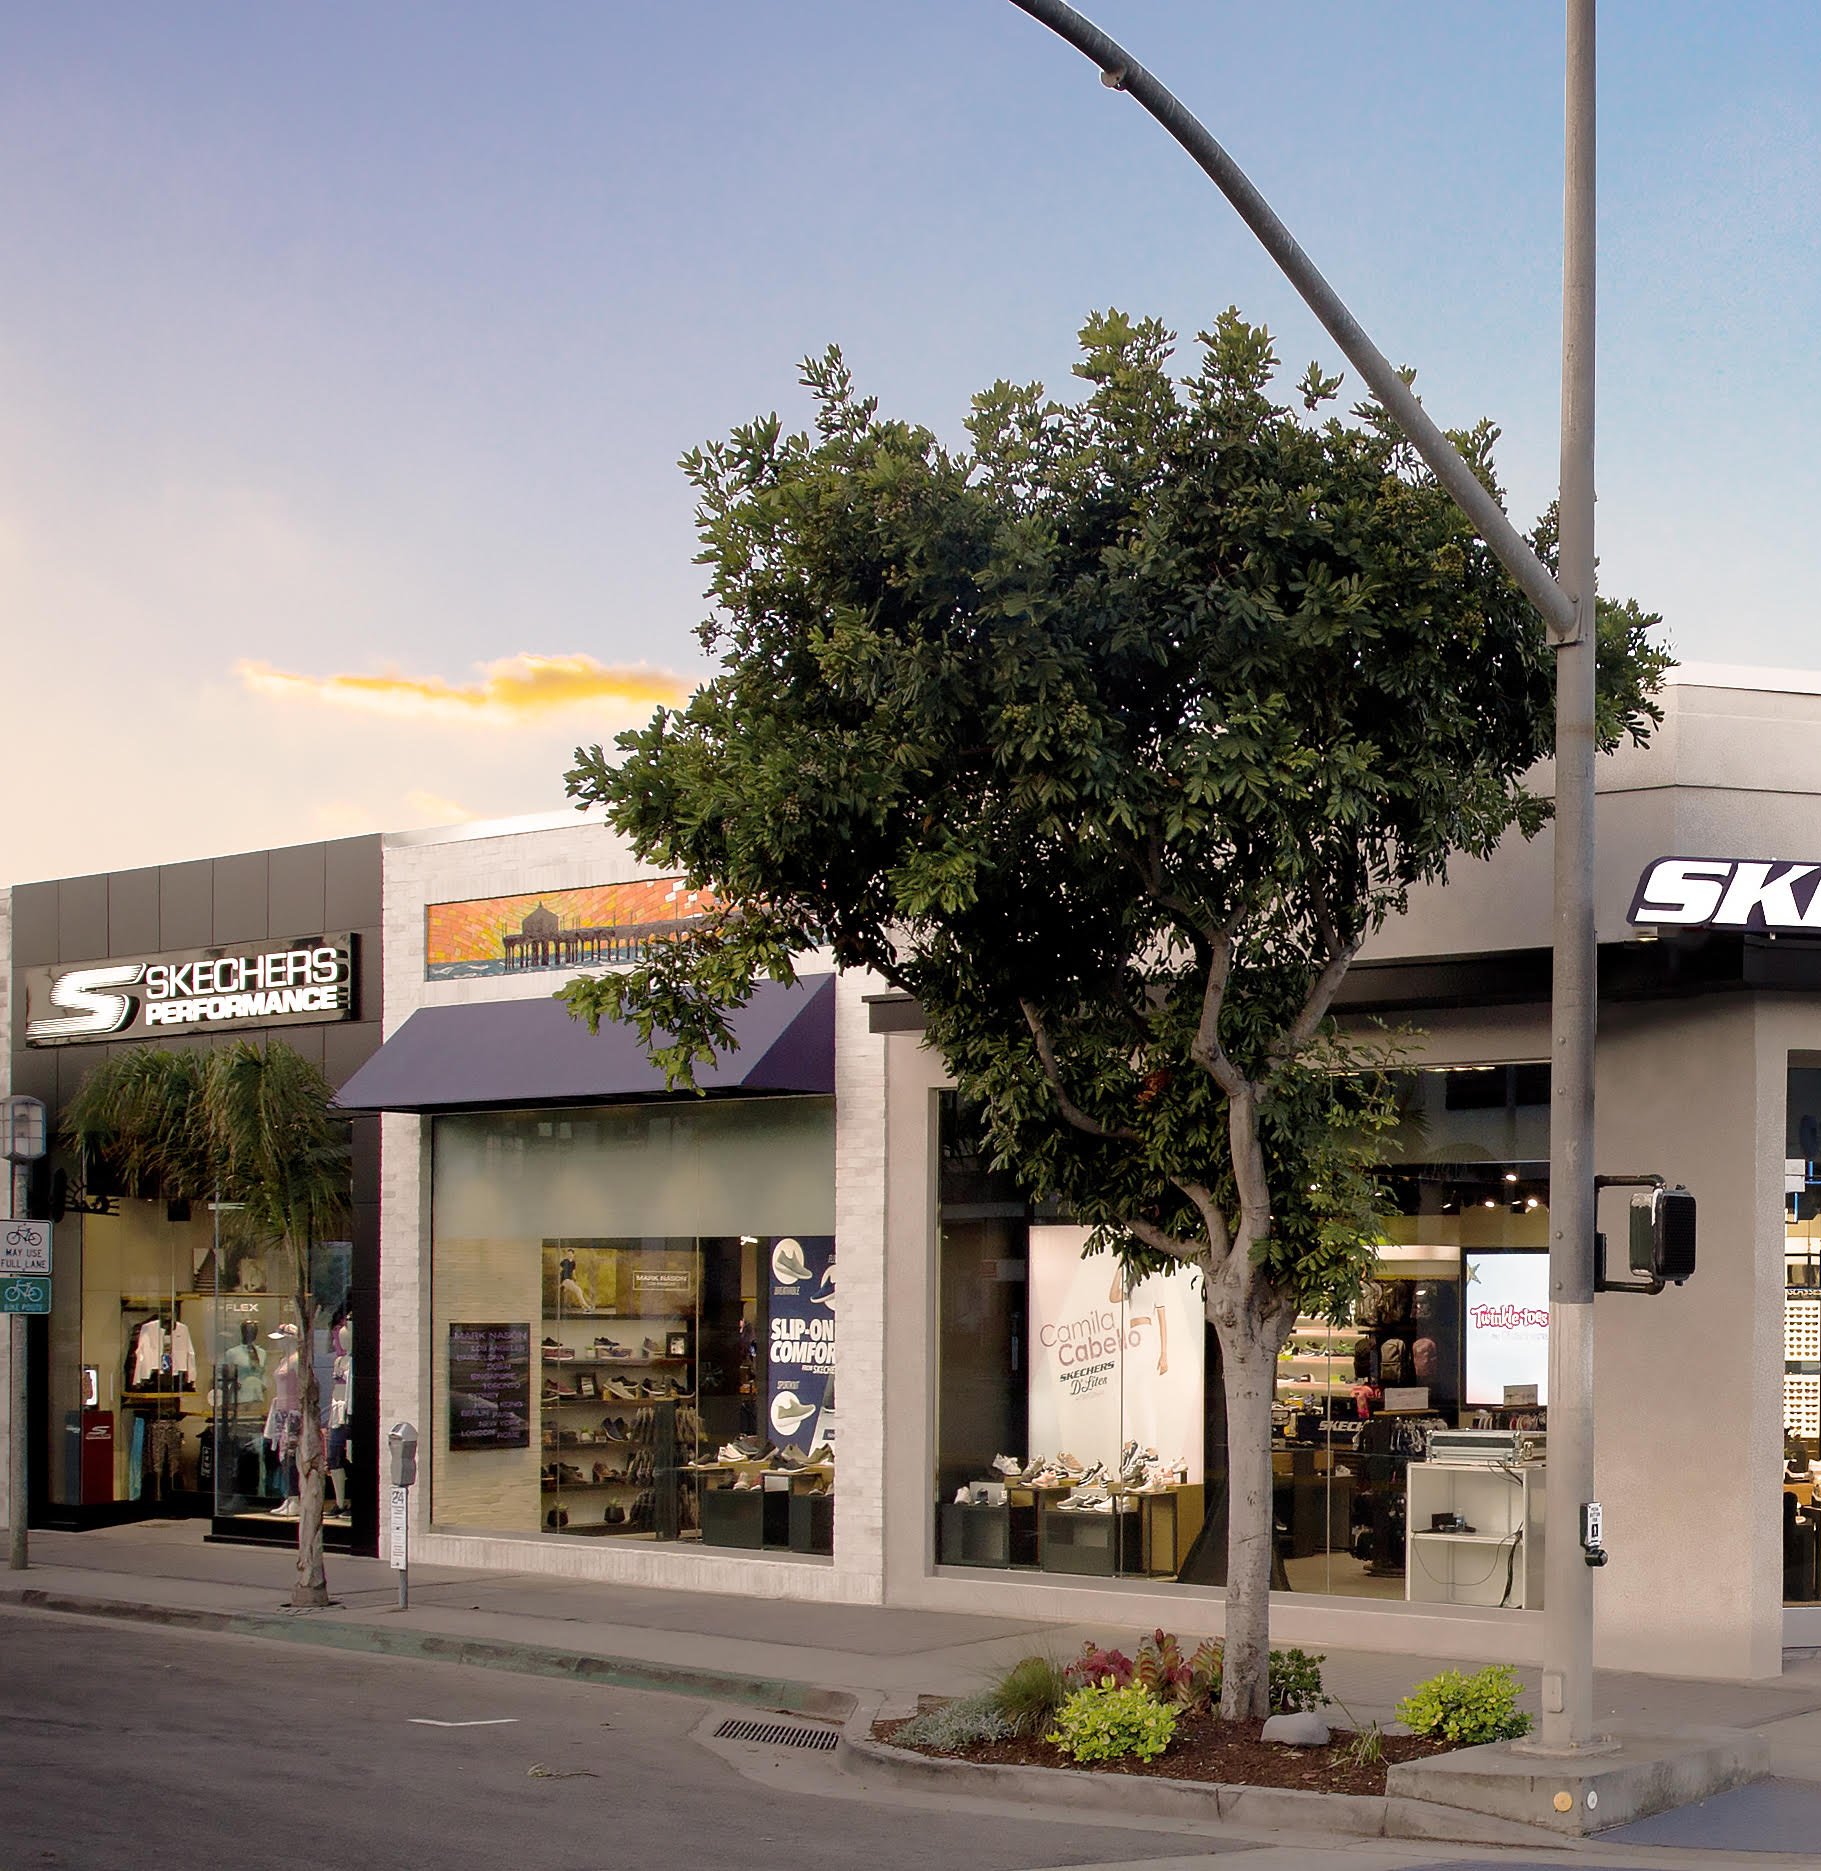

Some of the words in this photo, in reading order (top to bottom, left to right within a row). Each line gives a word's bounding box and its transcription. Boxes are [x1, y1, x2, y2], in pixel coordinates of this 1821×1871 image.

[146, 947, 338, 1000] SKECHERS
[145, 985, 339, 1026] PERFORMANCE
[1, 1258, 20, 1268] FULL
[25, 1260, 47, 1268] LANE
[6, 1248, 23, 1257] MAY
[26, 1249, 42, 1258] USE
[1040, 1309, 1115, 1347] Camila
[1470, 1304, 1520, 1329] Twinkle
[454, 1332, 486, 1340] MARK
[488, 1331, 528, 1340] NASON
[770, 1317, 835, 1342] SLIP-ON
[770, 1341, 836, 1364] COMFOR
[1058, 1328, 1142, 1366] Cabello
[1059, 1360, 1115, 1382] SKECHERS
[1317, 1420, 1364, 1432] SKECH
